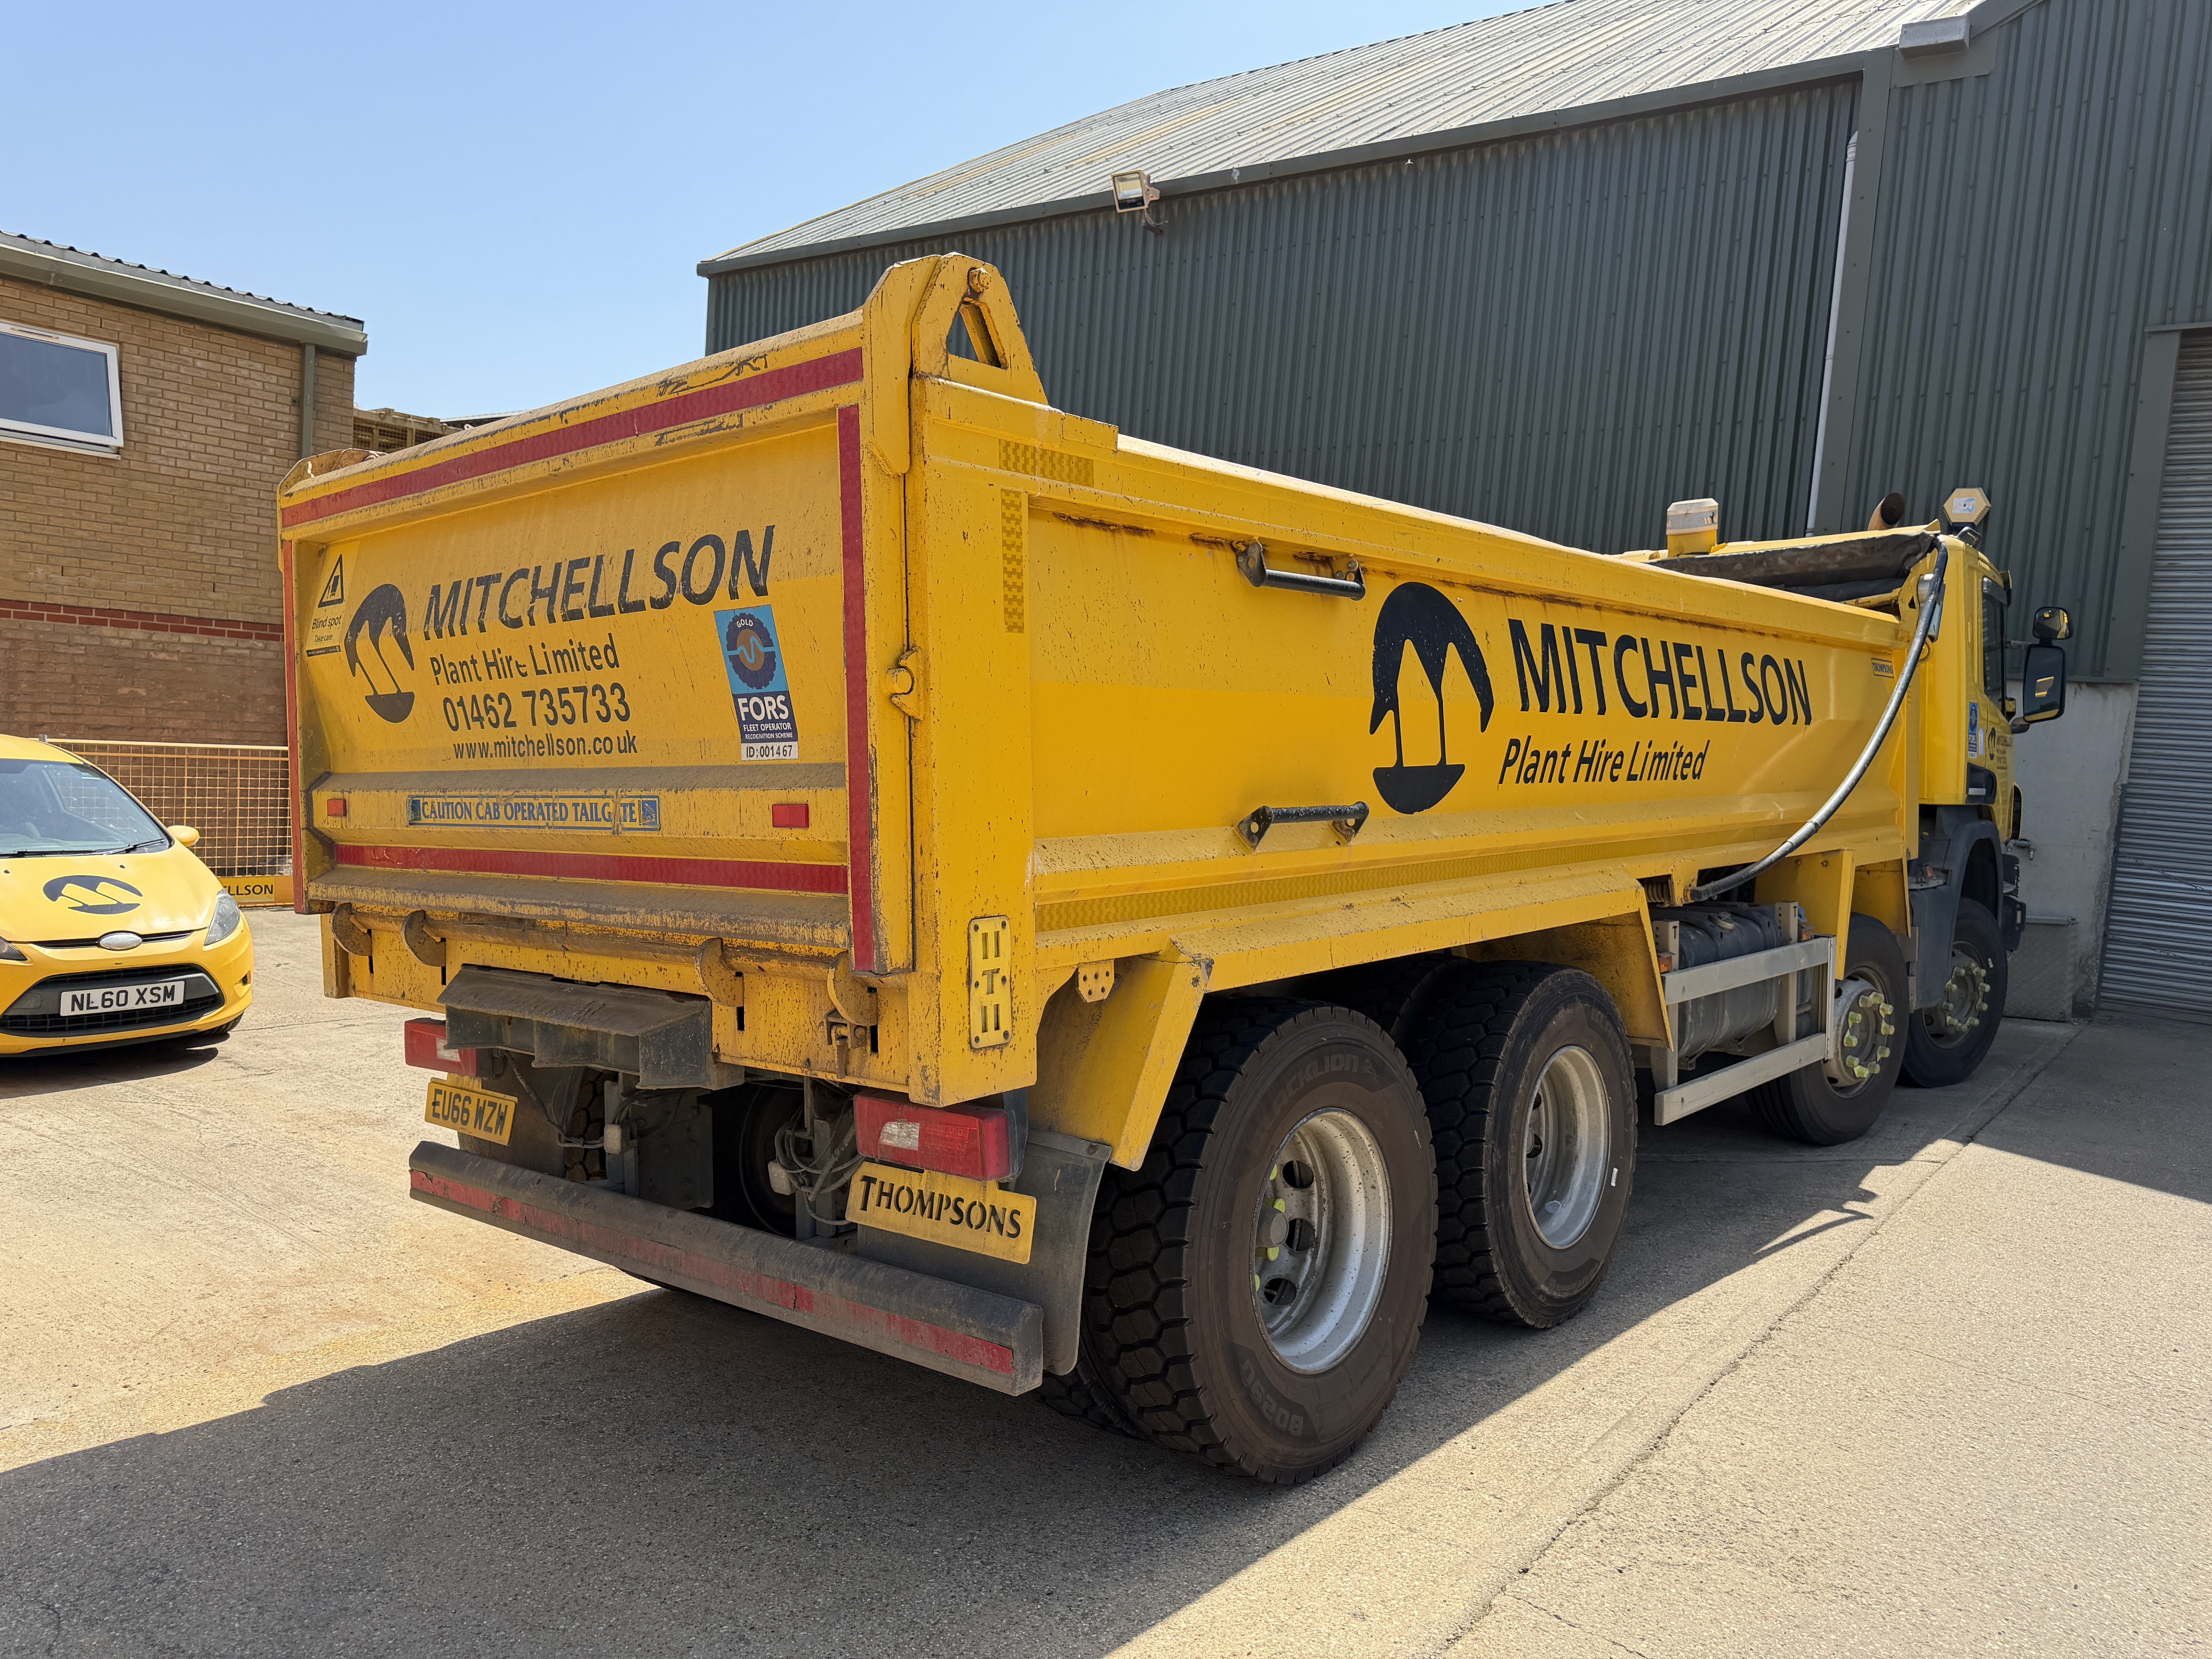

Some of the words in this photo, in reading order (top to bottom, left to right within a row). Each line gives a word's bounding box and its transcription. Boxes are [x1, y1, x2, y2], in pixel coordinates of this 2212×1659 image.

[424, 525, 775, 641] MITCHELLSON
[312, 616, 328, 630] Blind
[327, 614, 342, 629] spot
[737, 618, 753, 628] GOLD
[430, 654, 482, 685] Plant
[482, 647, 528, 680] Hire
[529, 633, 620, 676] Limited
[1508, 618, 1812, 726] MITCHELLSON
[443, 692, 517, 732] 01462
[521, 682, 630, 726] 735733
[738, 695, 789, 721] FORS
[453, 730, 637, 759] www.mitchellson.couk
[743, 723, 759, 732] FLEET
[760, 722, 792, 731] OPERATOR
[1498, 735, 1571, 785] Plant
[1572, 738, 1624, 783] Hire
[1626, 740, 1710, 782] Limited
[422, 801, 472, 822] CAUTION
[476, 802, 500, 820] CAB
[504, 802, 568, 822] OPERATED
[572, 802, 637, 823] TAILGTE
[70, 989, 128, 1012] NL60
[134, 984, 175, 1006] XSM
[431, 1088, 472, 1126] EU66
[473, 1098, 508, 1136] WZW
[860, 1175, 1021, 1238] THOMPSONS
